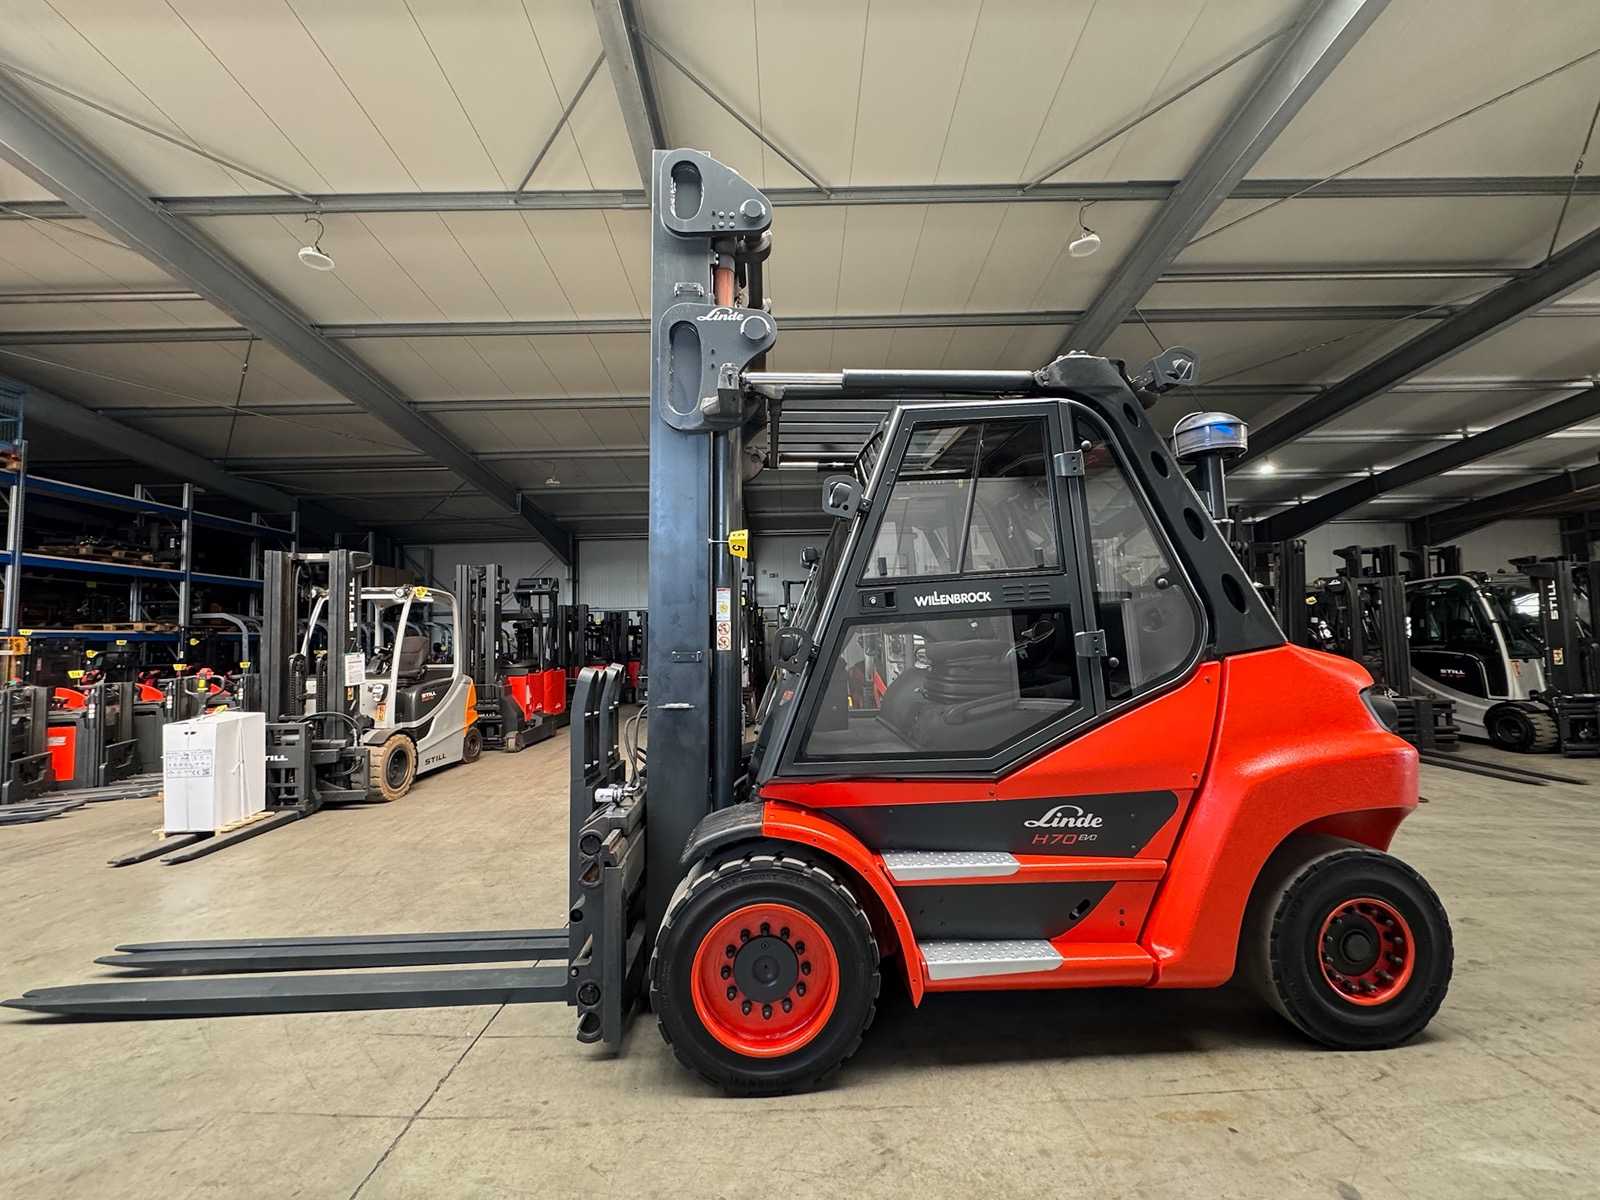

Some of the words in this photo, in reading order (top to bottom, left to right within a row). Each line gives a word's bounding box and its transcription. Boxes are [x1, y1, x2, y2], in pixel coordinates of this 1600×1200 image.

[696, 307, 744, 321] Linde
[914, 591, 992, 607] WILLENBROCK
[1547, 580, 1559, 620] STILL
[425, 753, 447, 765] STILL
[1023, 804, 1103, 828] Linde
[1031, 833, 1078, 845] H70
